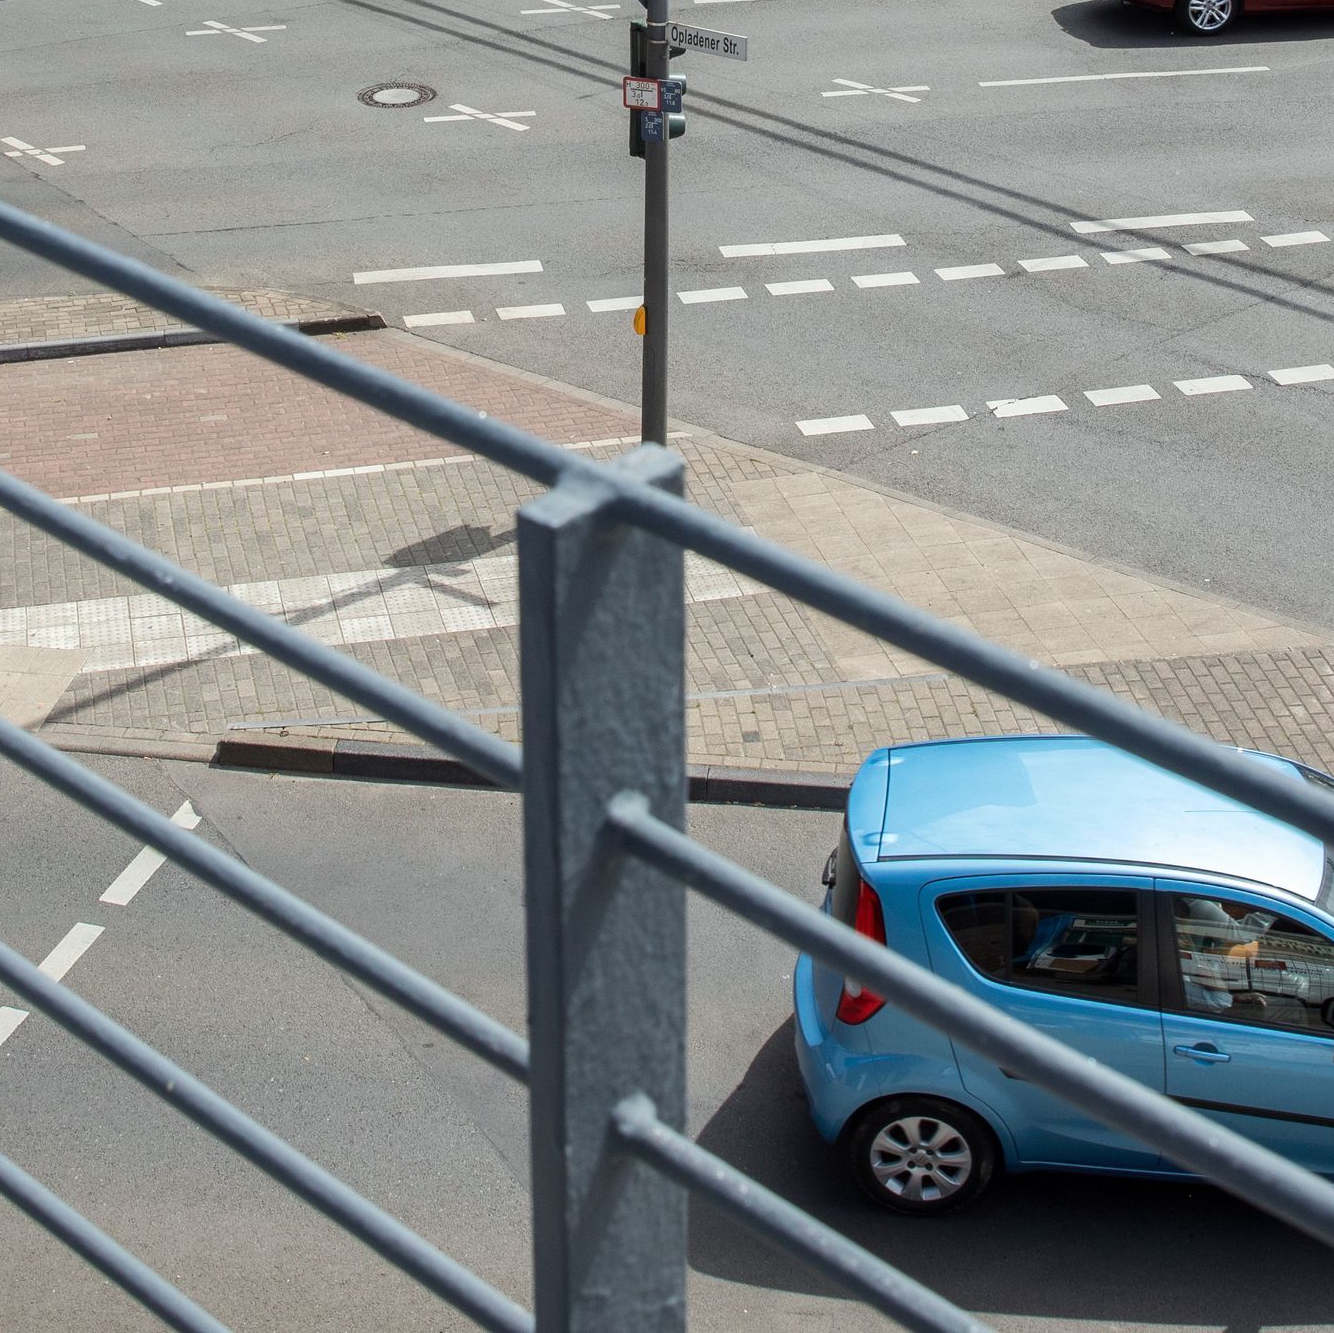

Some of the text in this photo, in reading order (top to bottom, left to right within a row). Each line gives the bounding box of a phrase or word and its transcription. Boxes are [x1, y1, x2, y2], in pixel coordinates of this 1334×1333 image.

[671, 26, 739, 56] Opladener Str.
[636, 81, 650, 89] 300
